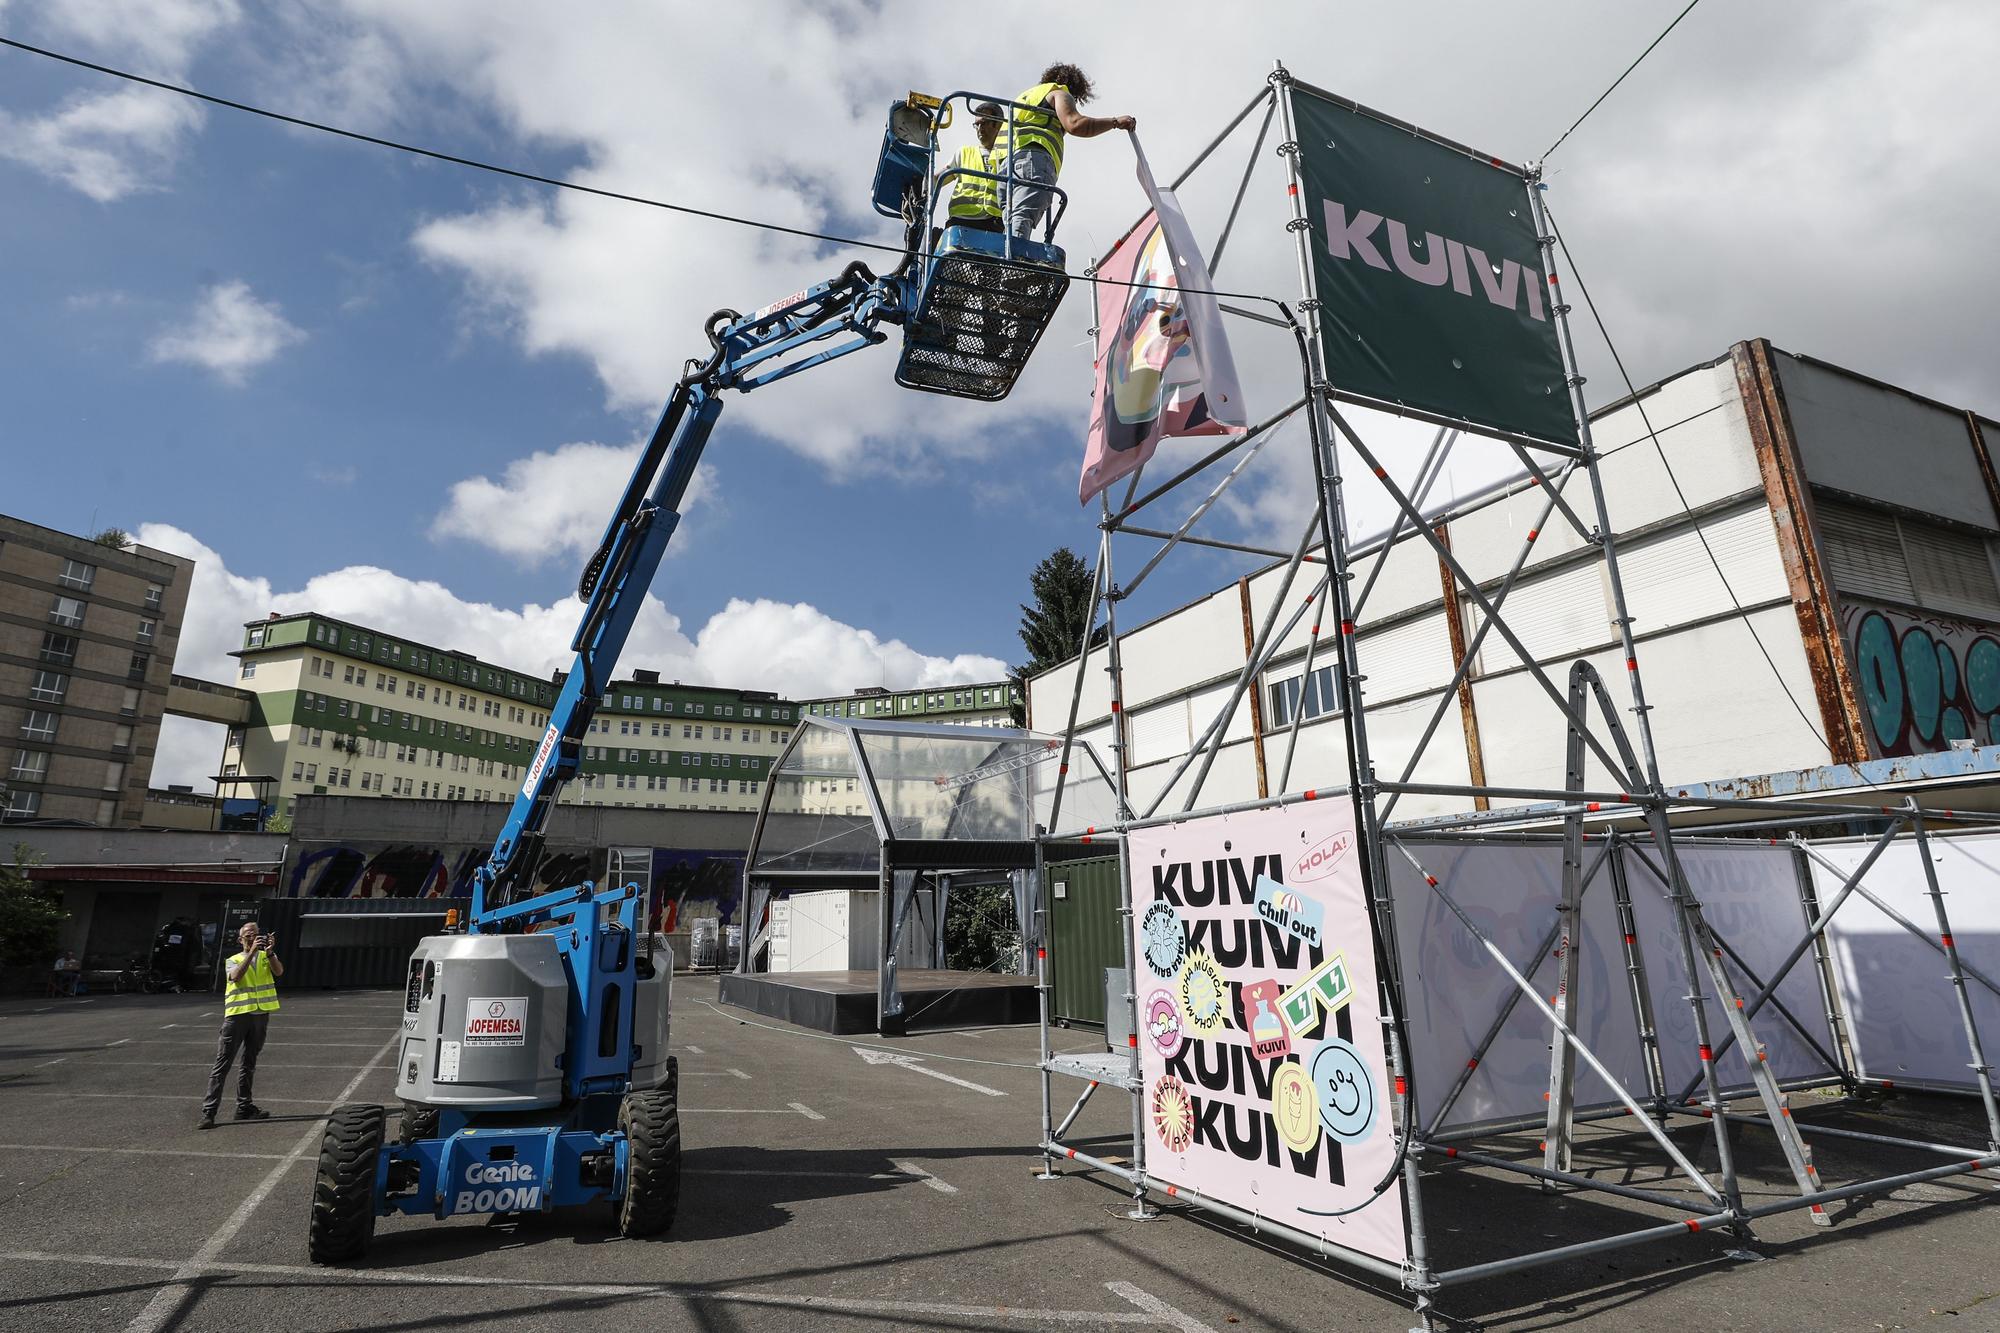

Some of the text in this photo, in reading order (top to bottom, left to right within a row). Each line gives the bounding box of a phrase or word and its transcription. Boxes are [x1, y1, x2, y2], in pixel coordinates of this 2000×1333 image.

[1323, 199, 1546, 322] KUIVI
[532, 727, 557, 779] JOFEMESA
[1298, 836, 1347, 875] HOLA!
[1142, 904, 1184, 978] PERMISO PARA BAILAR
[1258, 900, 1317, 942] Chill out
[1182, 967, 1194, 1017] MUCHA
[1194, 1001, 1222, 1029] MUCHA
[469, 1019, 520, 1033] JOFEMESA
[1257, 1039, 1286, 1055] KUIVI
[1165, 1037, 1301, 1101] KUIV
[465, 1161, 533, 1185] Genie
[454, 1187, 540, 1213] BOOM
